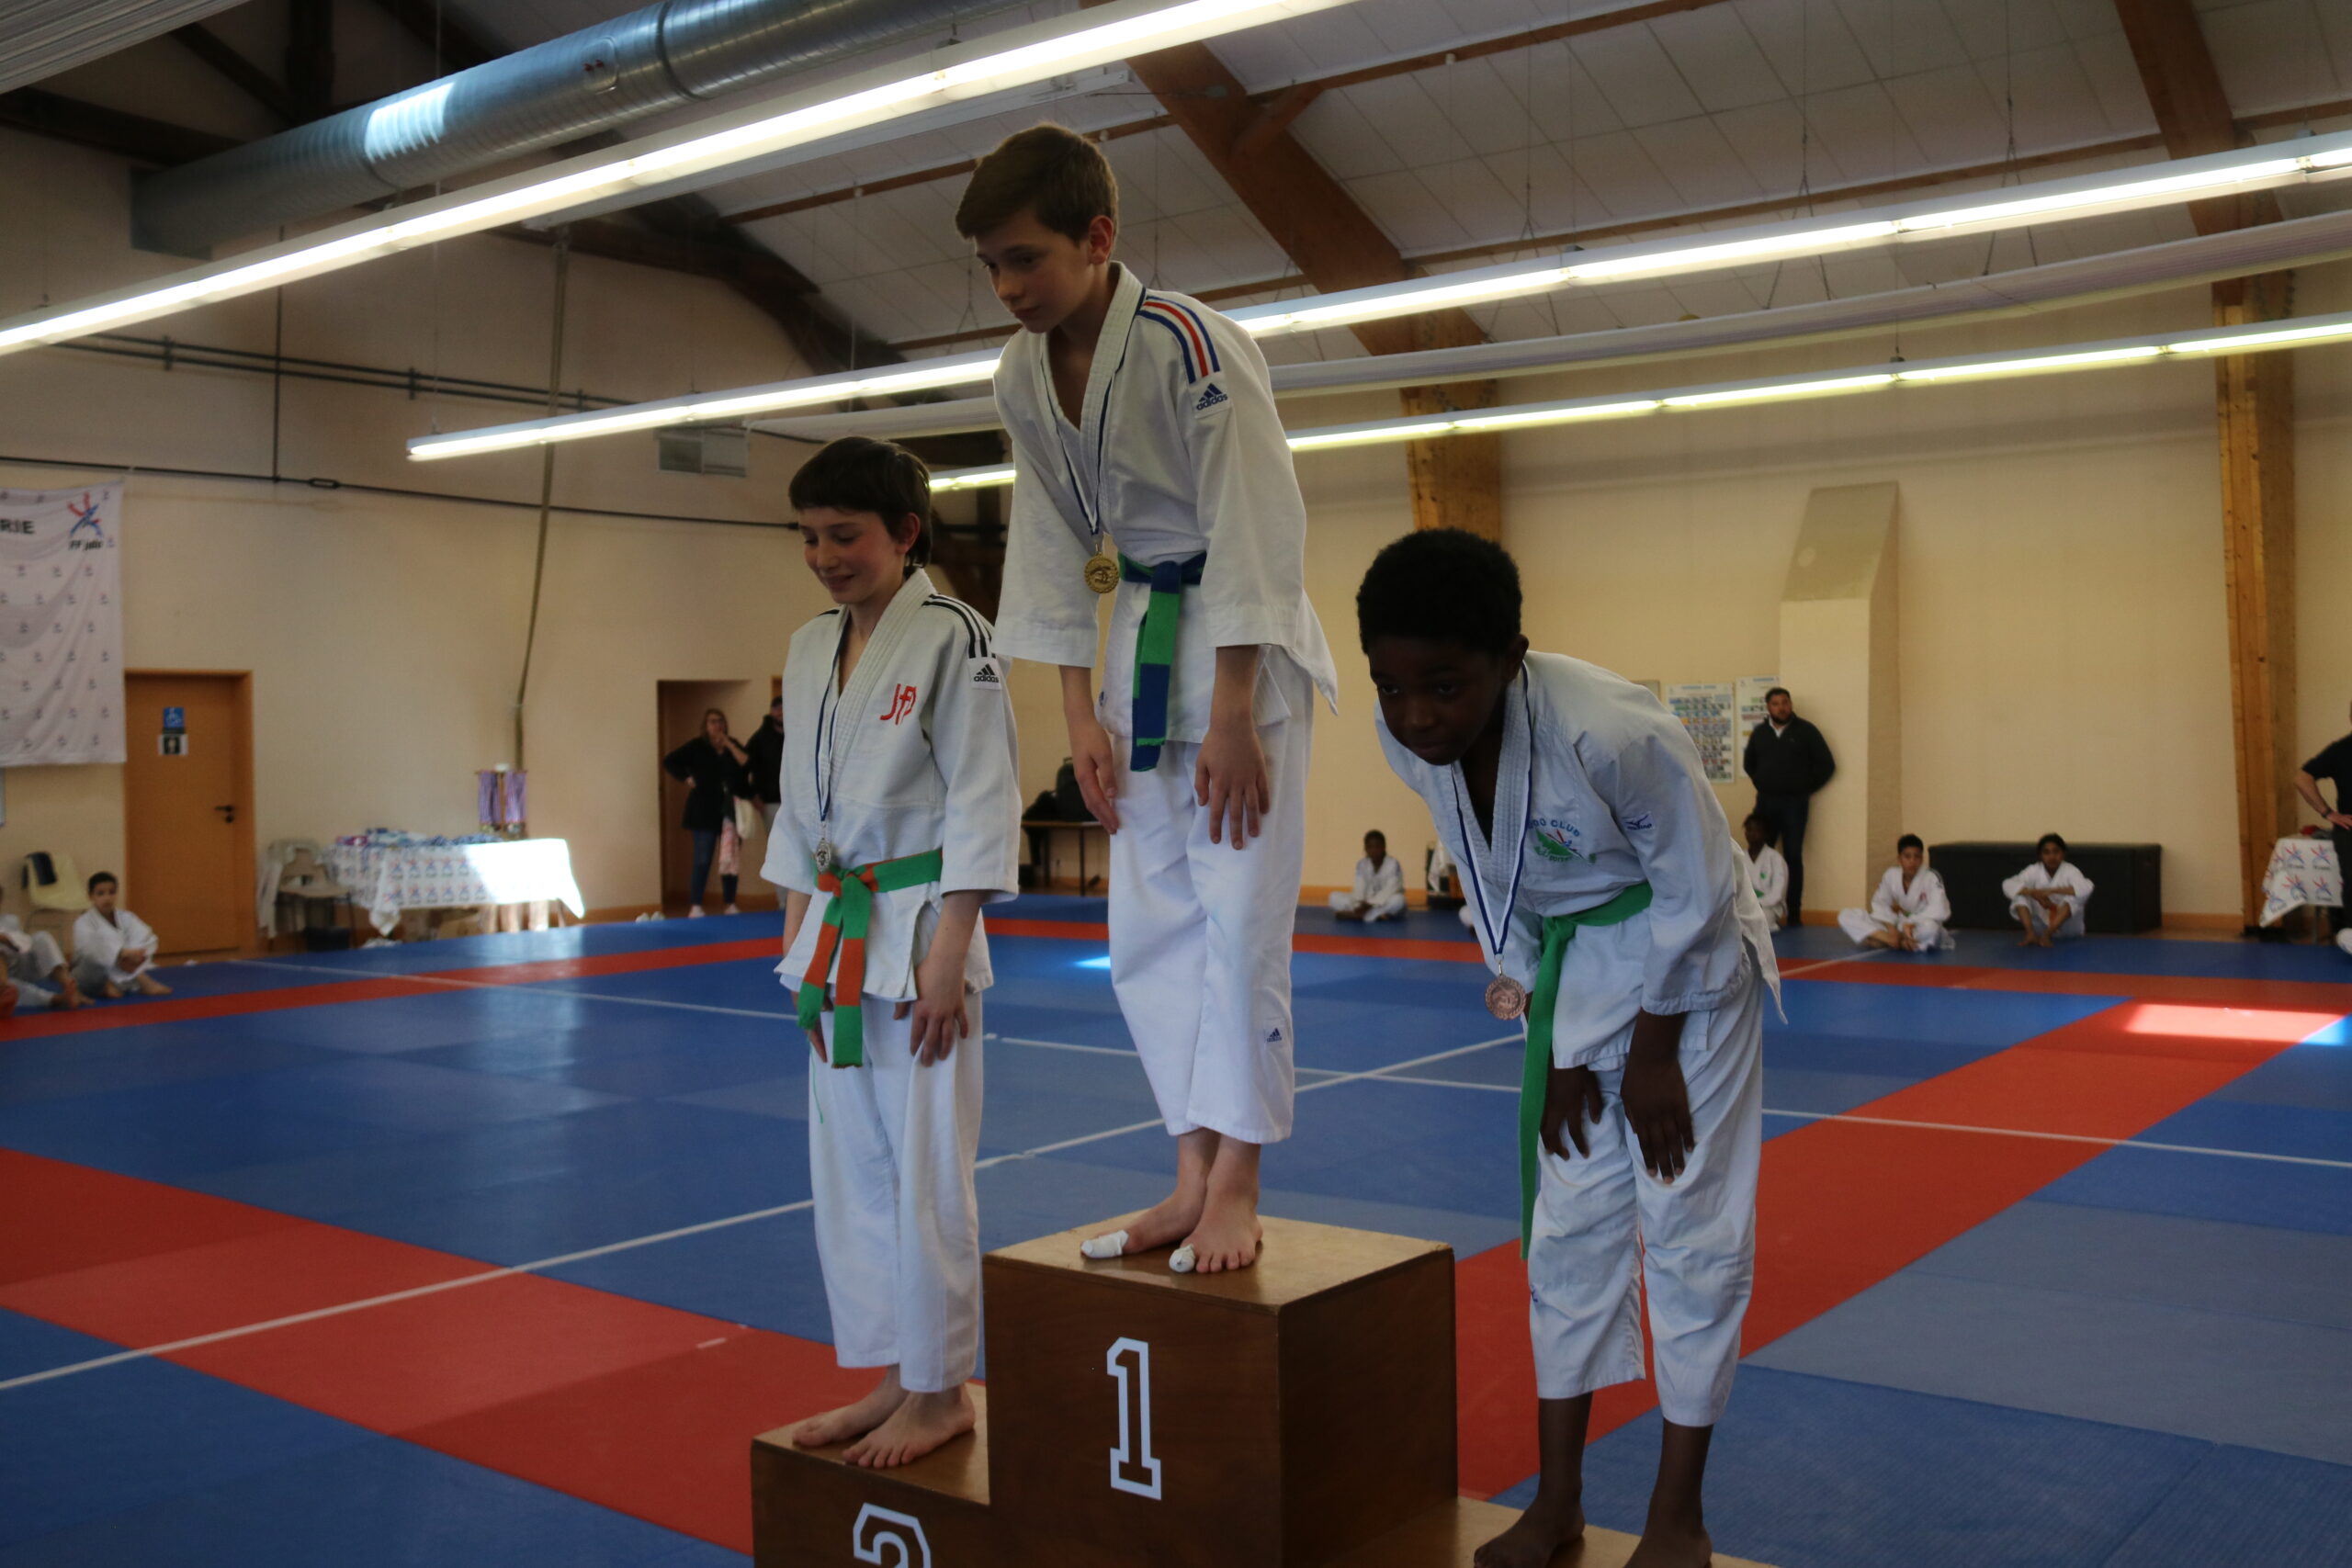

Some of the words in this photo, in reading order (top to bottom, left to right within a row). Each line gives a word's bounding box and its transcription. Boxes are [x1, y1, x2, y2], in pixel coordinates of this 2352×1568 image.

[1196, 394, 1227, 411] adidas
[974, 674, 1000, 683] adidas
[1106, 1337, 1162, 1500] 1
